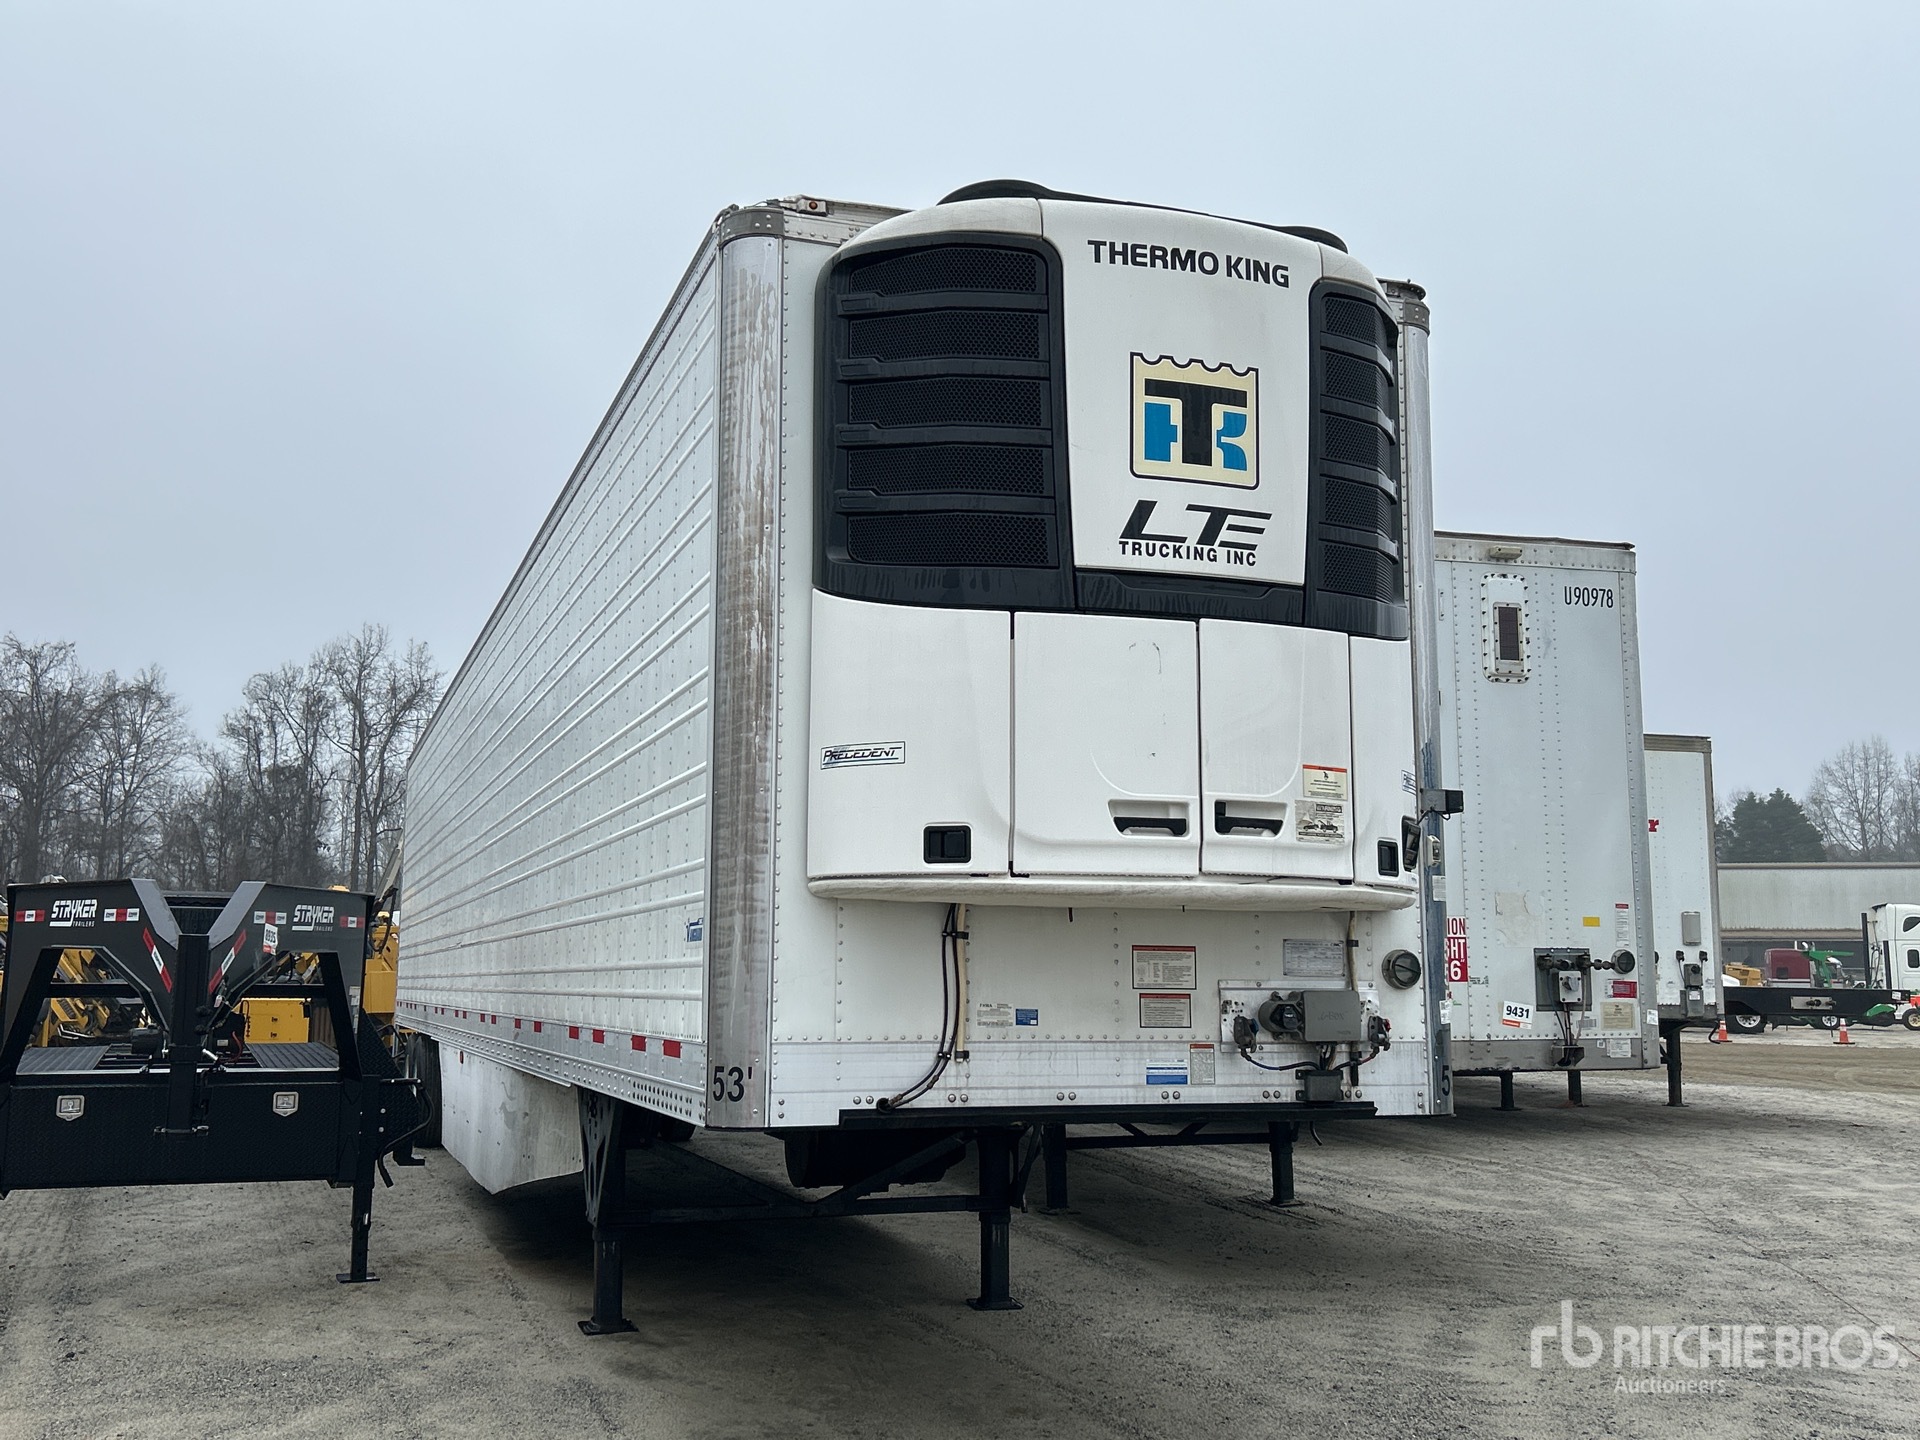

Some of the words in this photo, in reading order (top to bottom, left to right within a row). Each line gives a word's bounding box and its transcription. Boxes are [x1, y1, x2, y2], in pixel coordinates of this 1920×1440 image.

[1087, 239, 1219, 276] THERMO
[1225, 254, 1290, 289] KING
[1119, 499, 1272, 551] LTE
[1118, 540, 1218, 563] TRUCKING
[1226, 549, 1257, 567] INC
[1564, 585, 1614, 609] U90978
[822, 746, 903, 762] PRECEDENT
[49, 899, 98, 923] STRYKER
[292, 904, 335, 927] STRYKER
[1505, 1004, 1530, 1019] 9431
[712, 1065, 754, 1102] 53'
